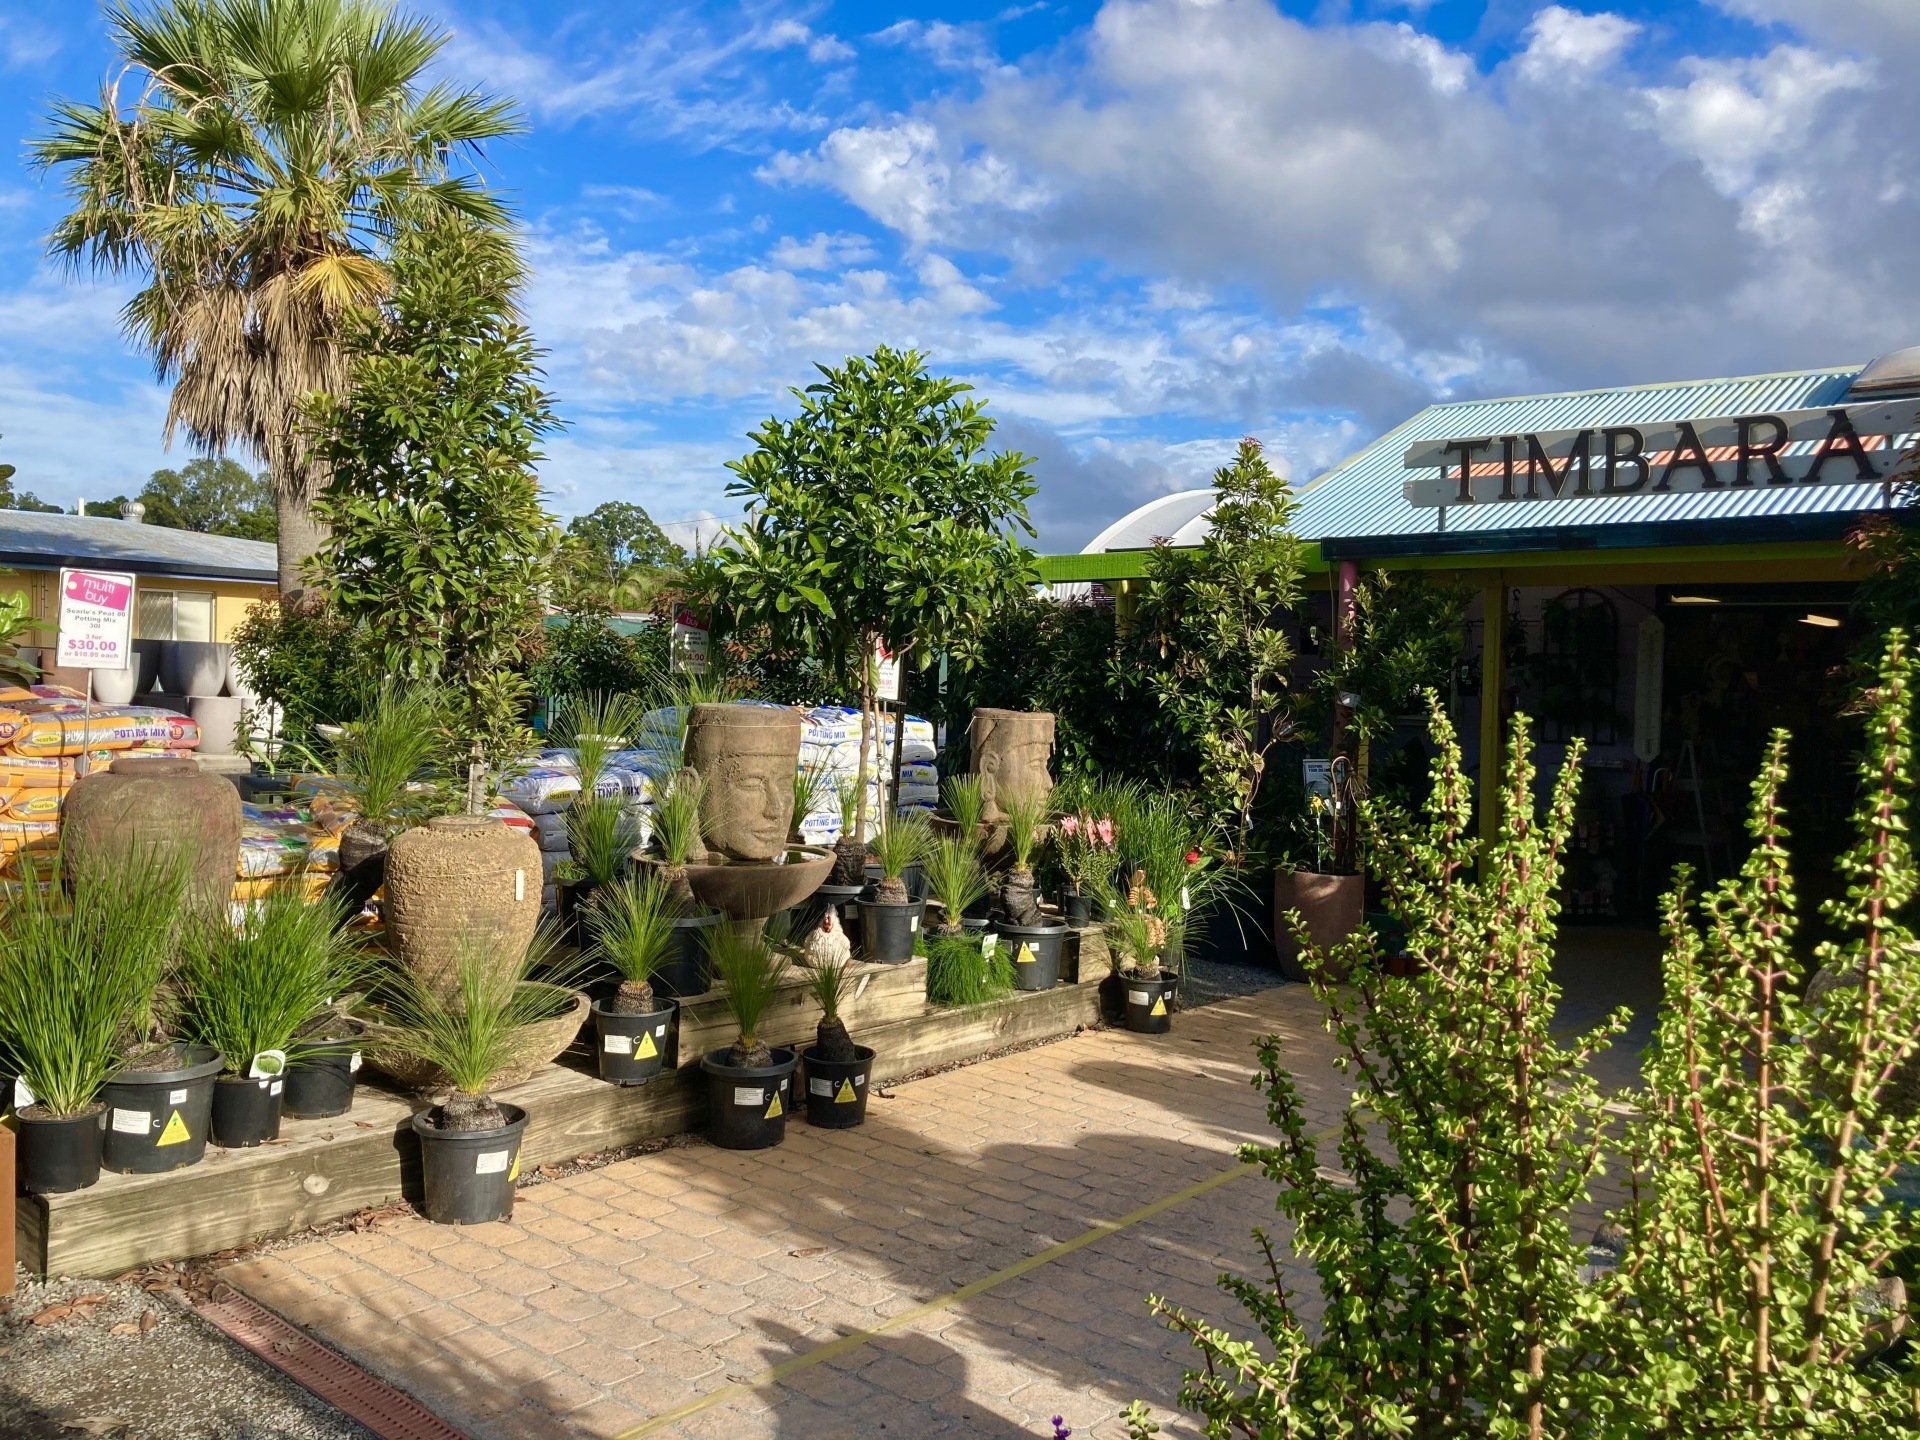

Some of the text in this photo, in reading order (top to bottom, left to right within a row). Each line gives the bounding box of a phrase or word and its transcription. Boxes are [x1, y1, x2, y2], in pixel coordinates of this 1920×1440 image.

[1445, 409, 1883, 502] TIMBARA
[83, 579, 115, 594] multi
[85, 589, 108, 606] buy
[75, 615, 101, 623] Potting
[68, 639, 117, 651] $30.00
[114, 728, 147, 739] POTTING
[150, 728, 166, 737] MIX
[808, 728, 833, 739] POTTING
[834, 731, 846, 739] MIX
[902, 770, 913, 778] MIX
[804, 818, 830, 827] POTTING
